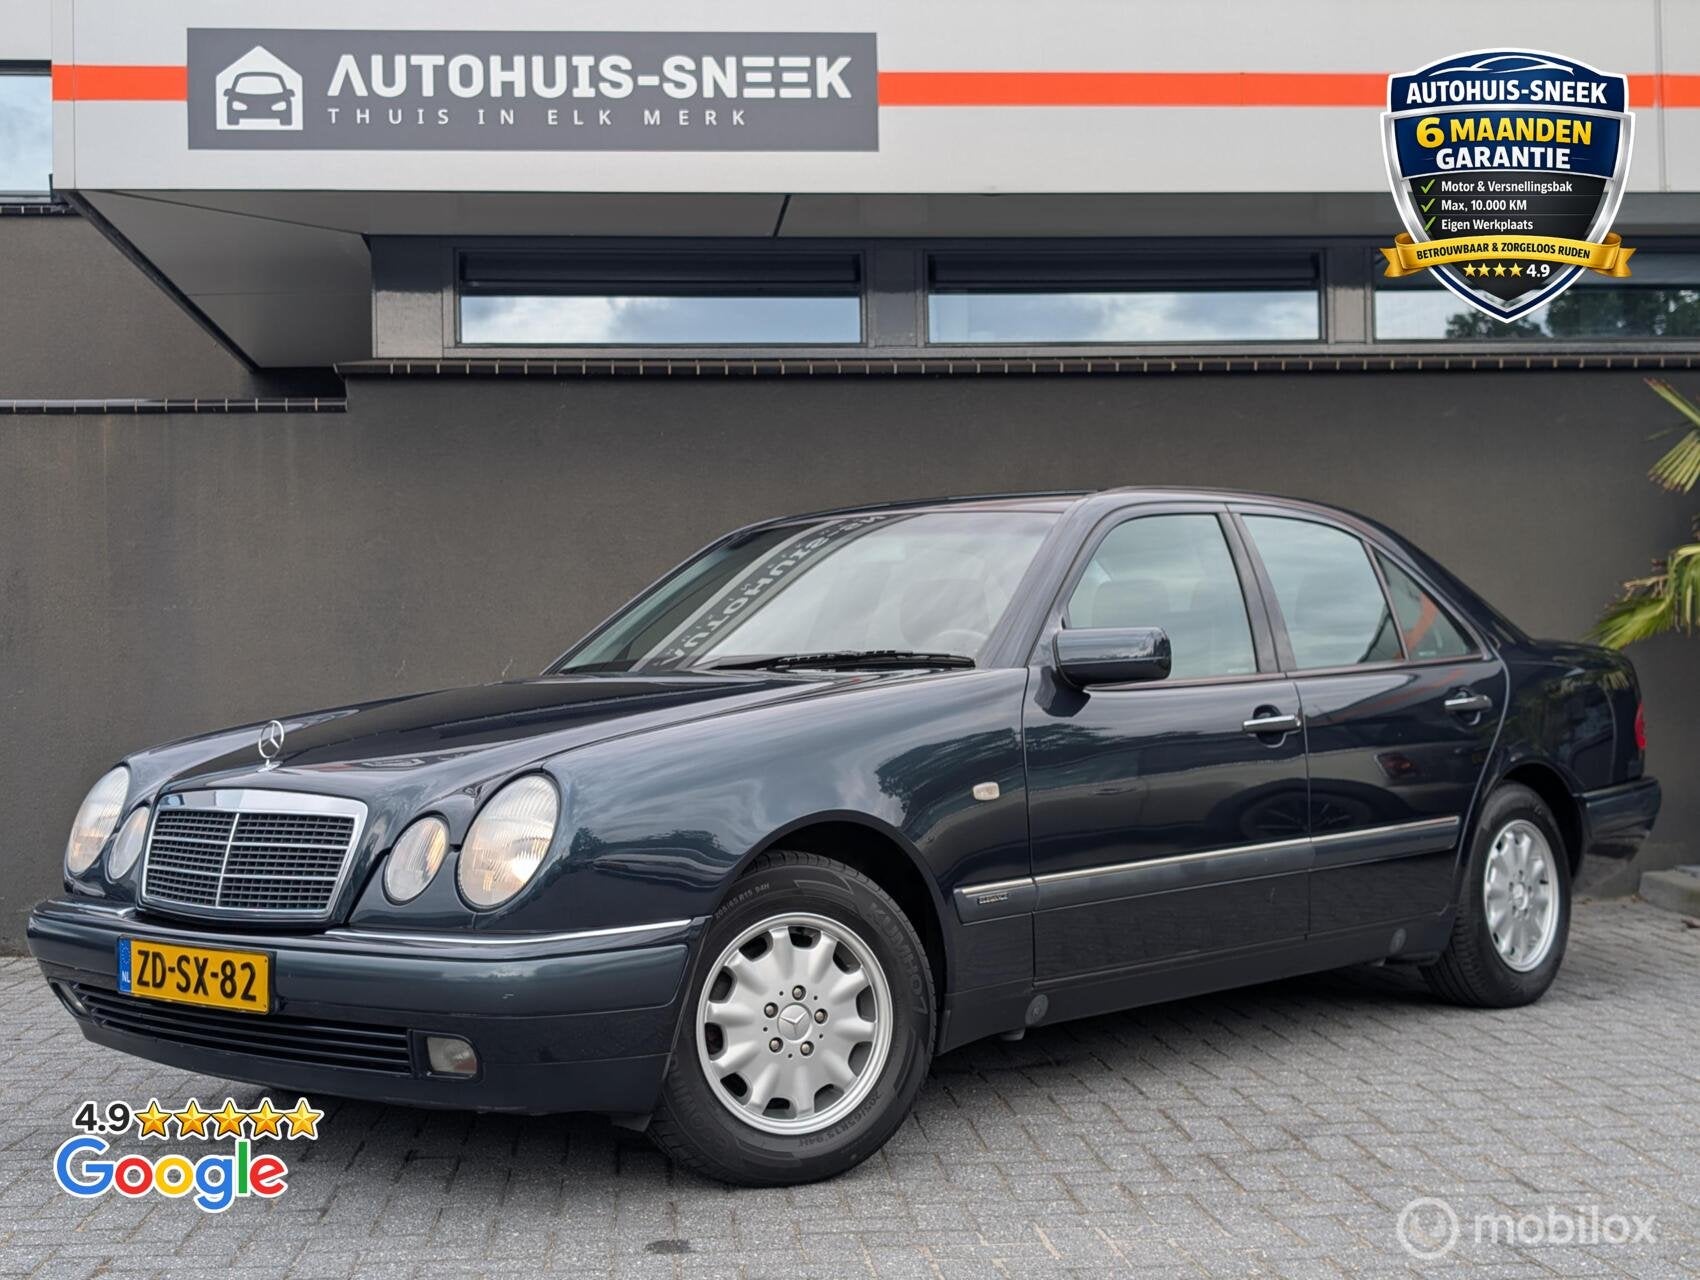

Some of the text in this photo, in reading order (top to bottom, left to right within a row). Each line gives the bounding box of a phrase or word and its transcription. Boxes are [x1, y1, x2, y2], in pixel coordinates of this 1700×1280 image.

[327, 54, 852, 99] AUTOHUIS-SNEEK
[327, 108, 745, 126] THUIS IN ELK MERK
[121, 970, 131, 983] NL
[136, 949, 257, 1002] ZD-SX-82
